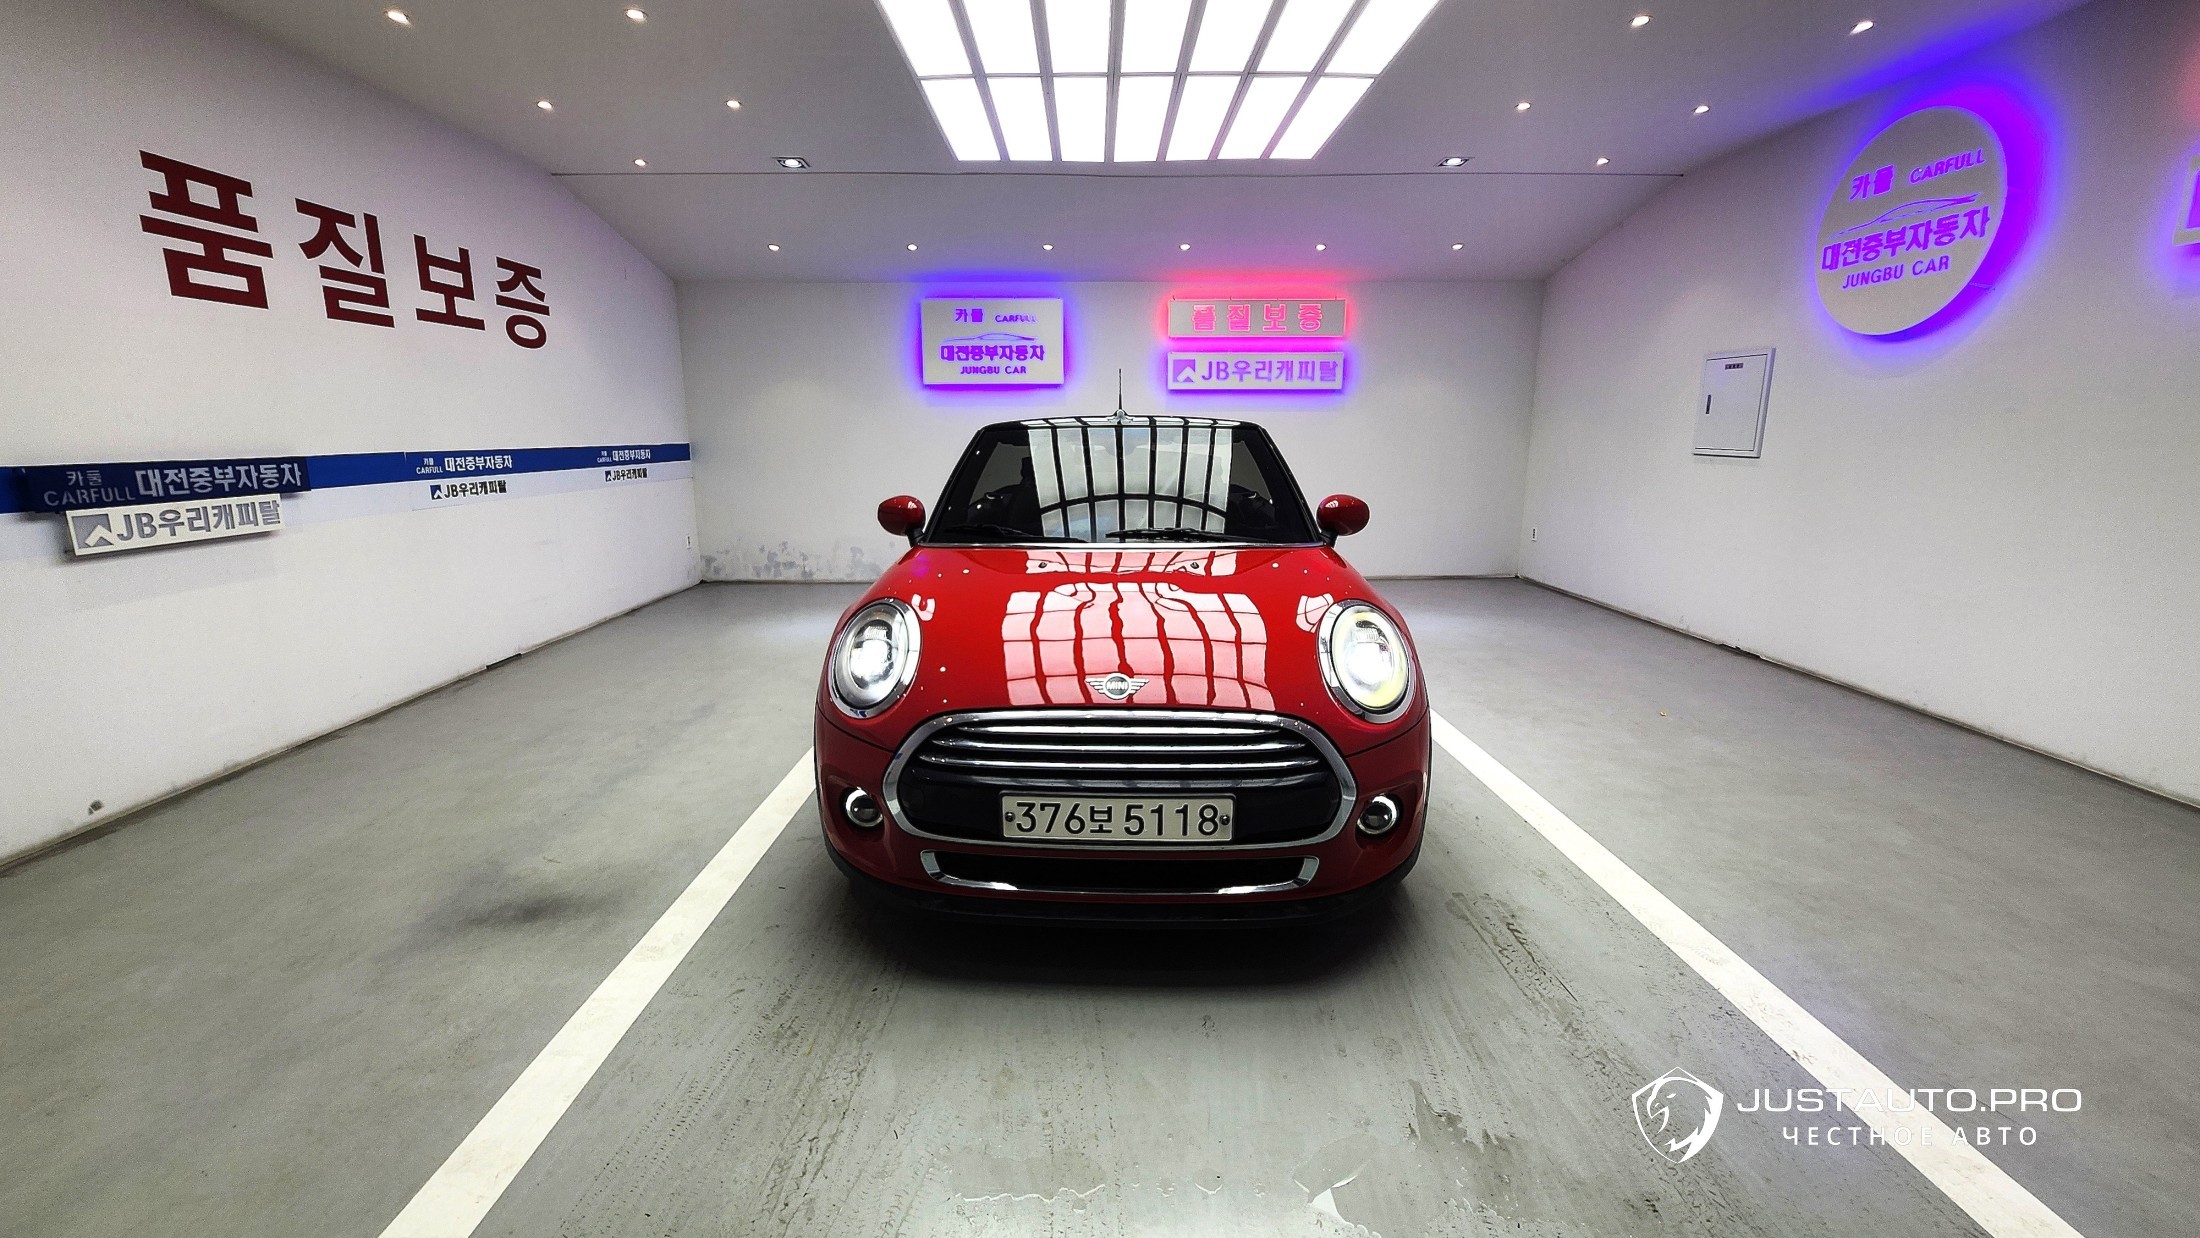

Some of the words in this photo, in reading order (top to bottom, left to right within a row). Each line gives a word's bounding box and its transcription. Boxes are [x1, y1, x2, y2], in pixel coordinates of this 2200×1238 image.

[1850, 164, 1895, 201] 카
[1909, 149, 1985, 184] CARFULL
[1842, 263, 1905, 290] JUNGBU
[1912, 254, 1951, 277] CAR
[955, 308, 984, 323] 카
[960, 365, 1001, 375] JUNGBU
[1004, 365, 1028, 375] CAR
[1201, 359, 1339, 382] JB우리캐피탈
[416, 465, 444, 475] CARFULL
[43, 486, 136, 506] CARFULL
[116, 499, 281, 542] JB우리캐피탈
[1106, 680, 1128, 690] MINI
[1015, 800, 1113, 835] 376보
[1123, 803, 1219, 836] 5118
